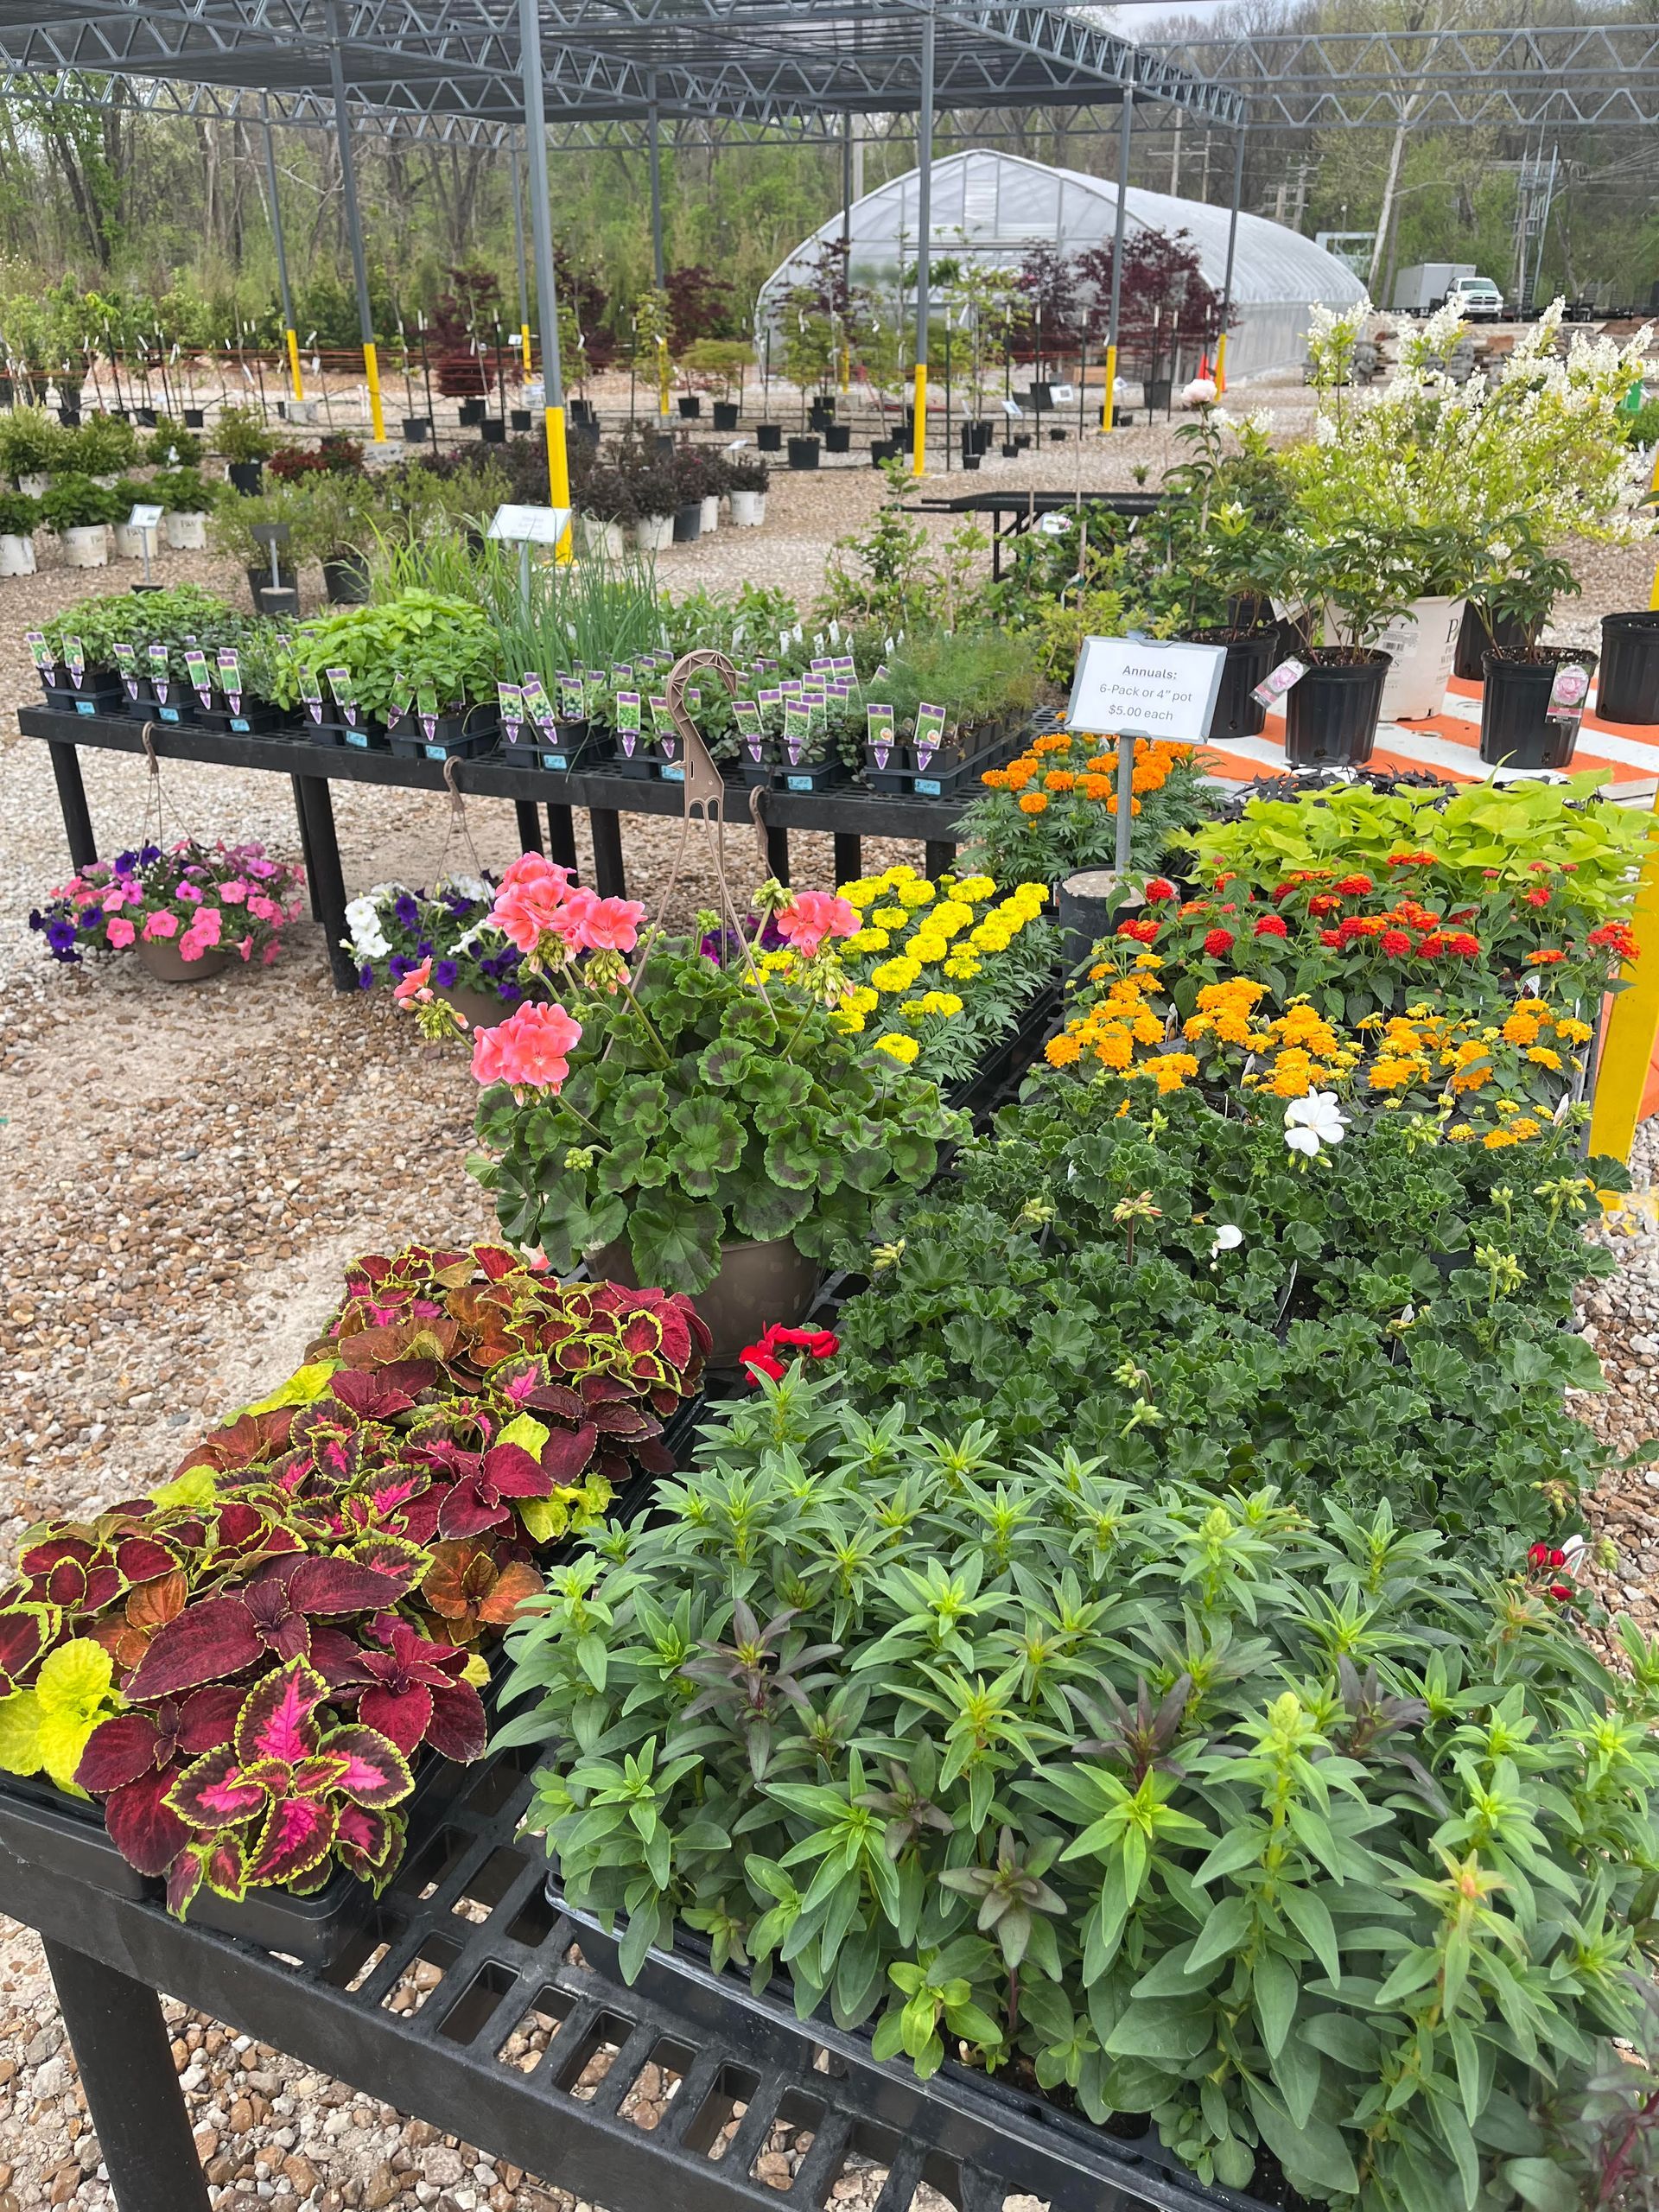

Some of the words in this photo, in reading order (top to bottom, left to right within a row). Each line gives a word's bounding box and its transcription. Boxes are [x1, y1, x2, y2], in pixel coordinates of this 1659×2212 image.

[1122, 664, 1178, 680] Annuals:
[1099, 683, 1140, 696] 6-Pack
[1142, 690, 1154, 698] or
[1172, 692, 1192, 702] pot
[1108, 704, 1141, 717] $5.00
[1144, 709, 1173, 721] each
